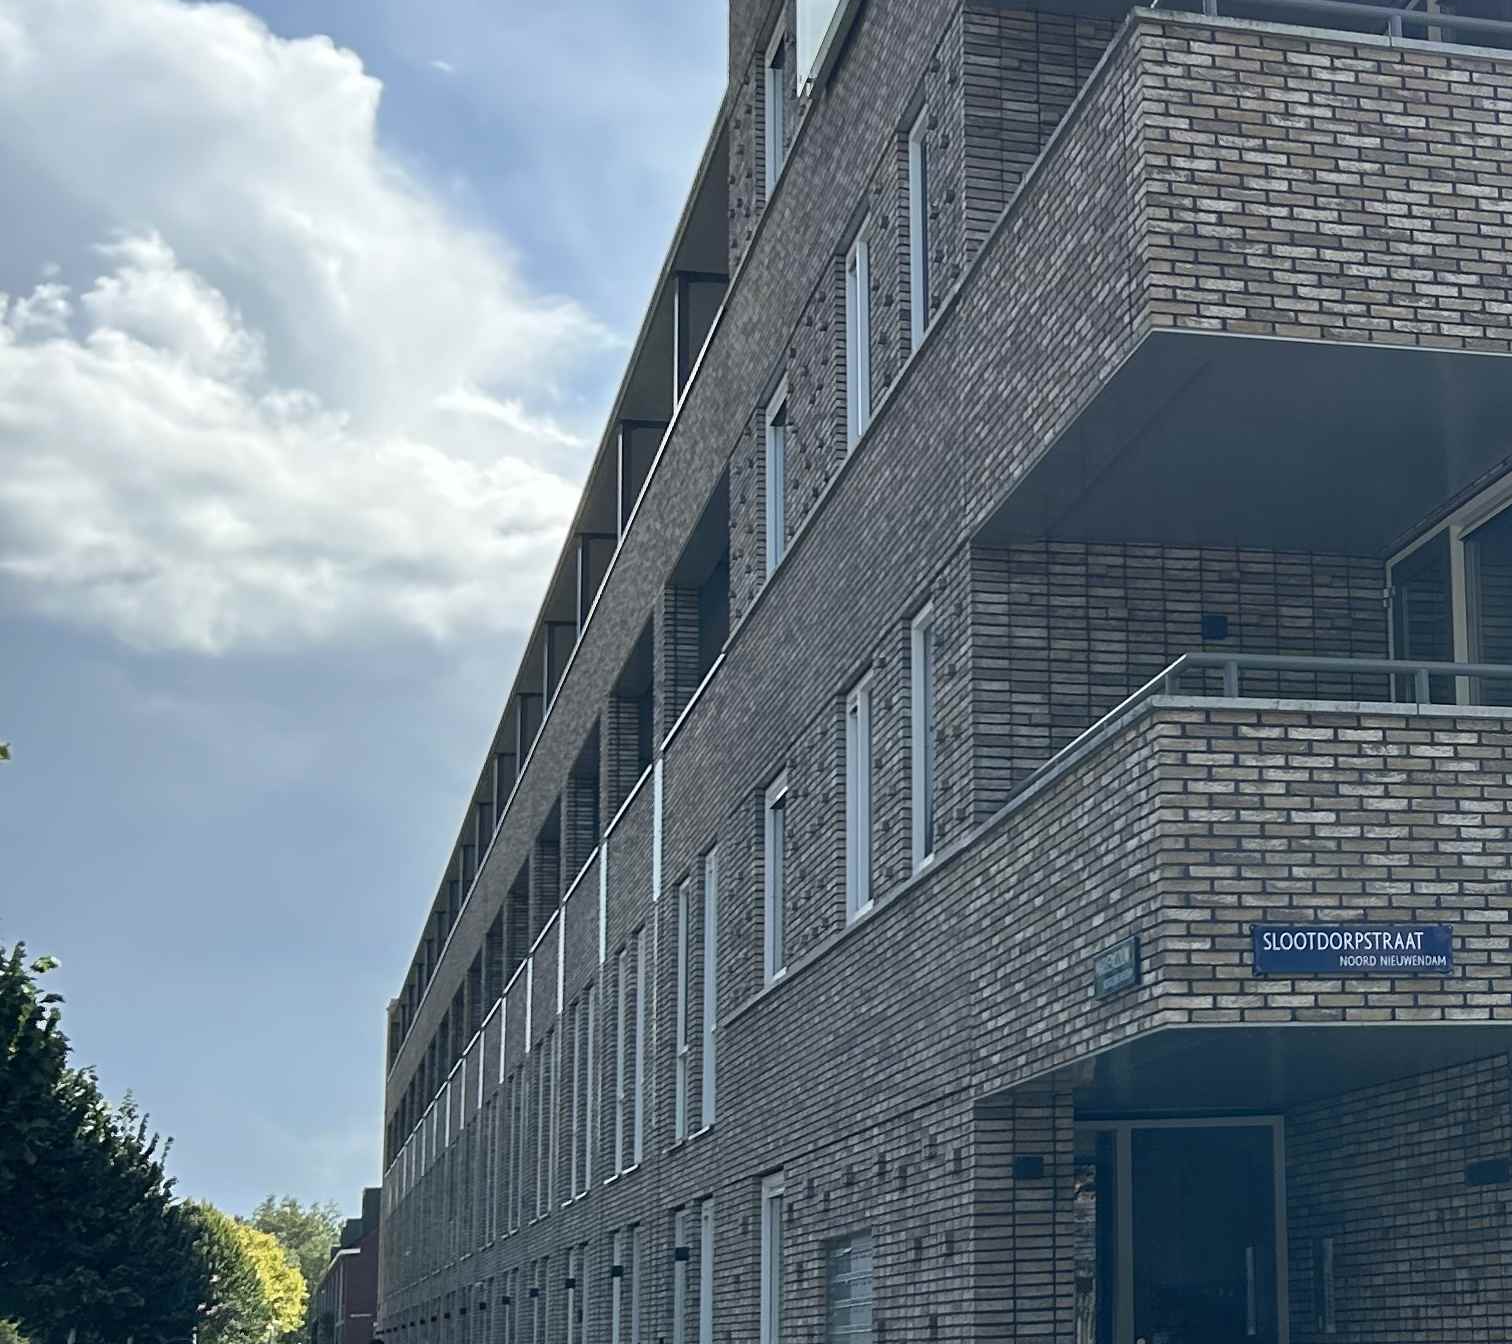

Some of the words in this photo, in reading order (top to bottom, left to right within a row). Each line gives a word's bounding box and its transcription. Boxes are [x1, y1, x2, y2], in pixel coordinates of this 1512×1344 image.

[1263, 931, 1424, 951] SLOOTDORPSTRAAT
[1339, 955, 1377, 967] NOORD
[1380, 955, 1447, 967] NIEUWENDAM
